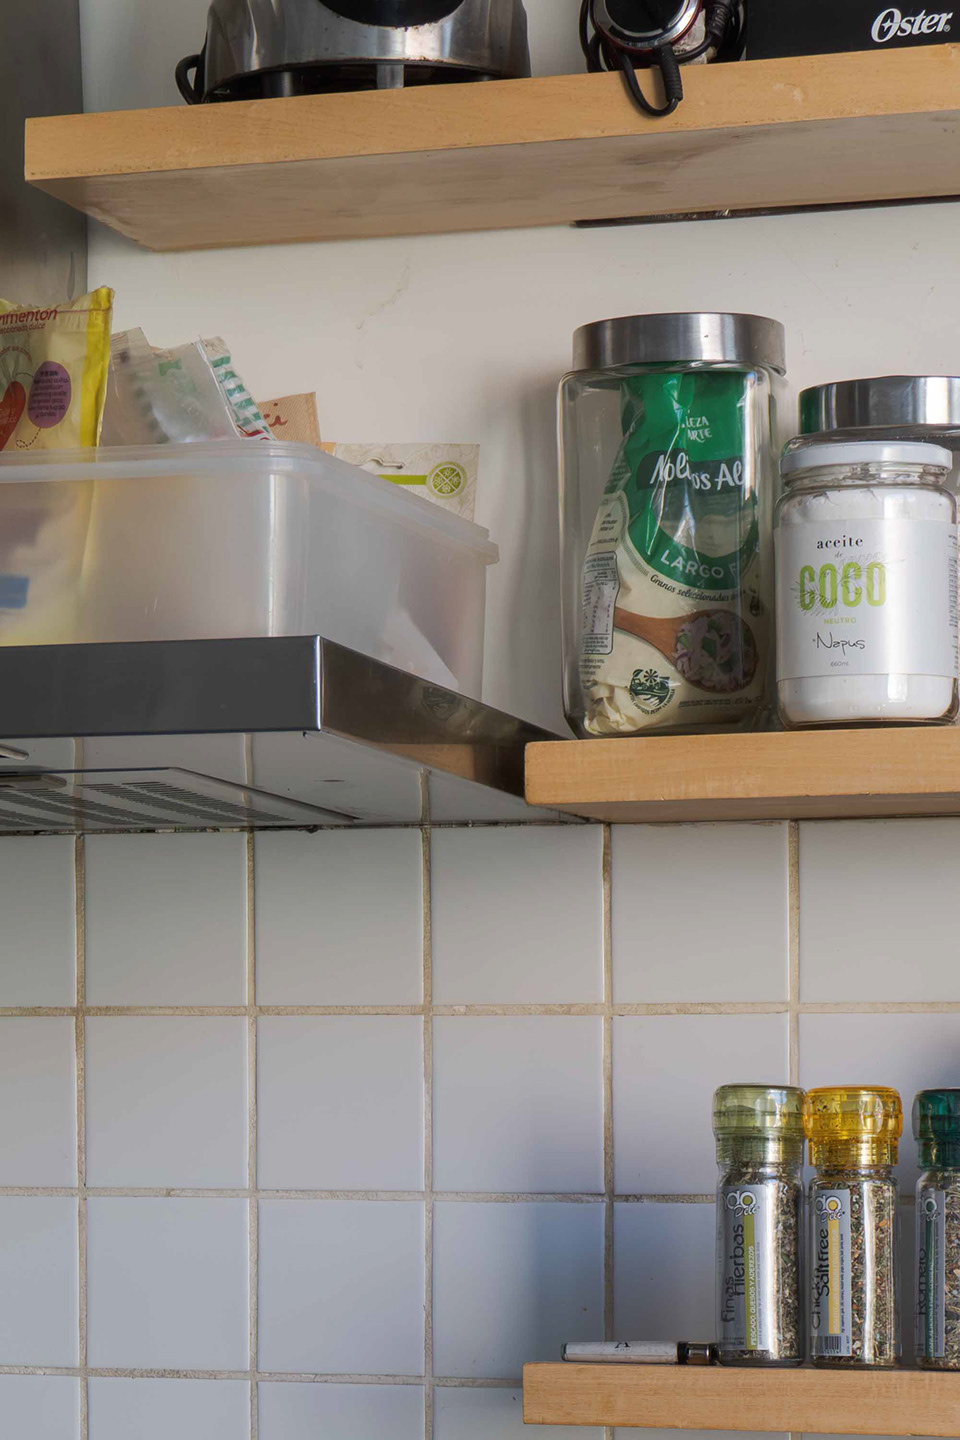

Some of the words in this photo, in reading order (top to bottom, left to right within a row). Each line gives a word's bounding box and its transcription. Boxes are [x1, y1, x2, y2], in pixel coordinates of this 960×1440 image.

[871, 8, 953, 42] Oster
[816, 535, 863, 549] aceite
[660, 549, 724, 578] LARGO
[650, 574, 676, 593] Granos
[799, 561, 886, 611] COCO
[823, 617, 857, 625] NEUTRO
[729, 1224, 746, 1297] Hierbas
